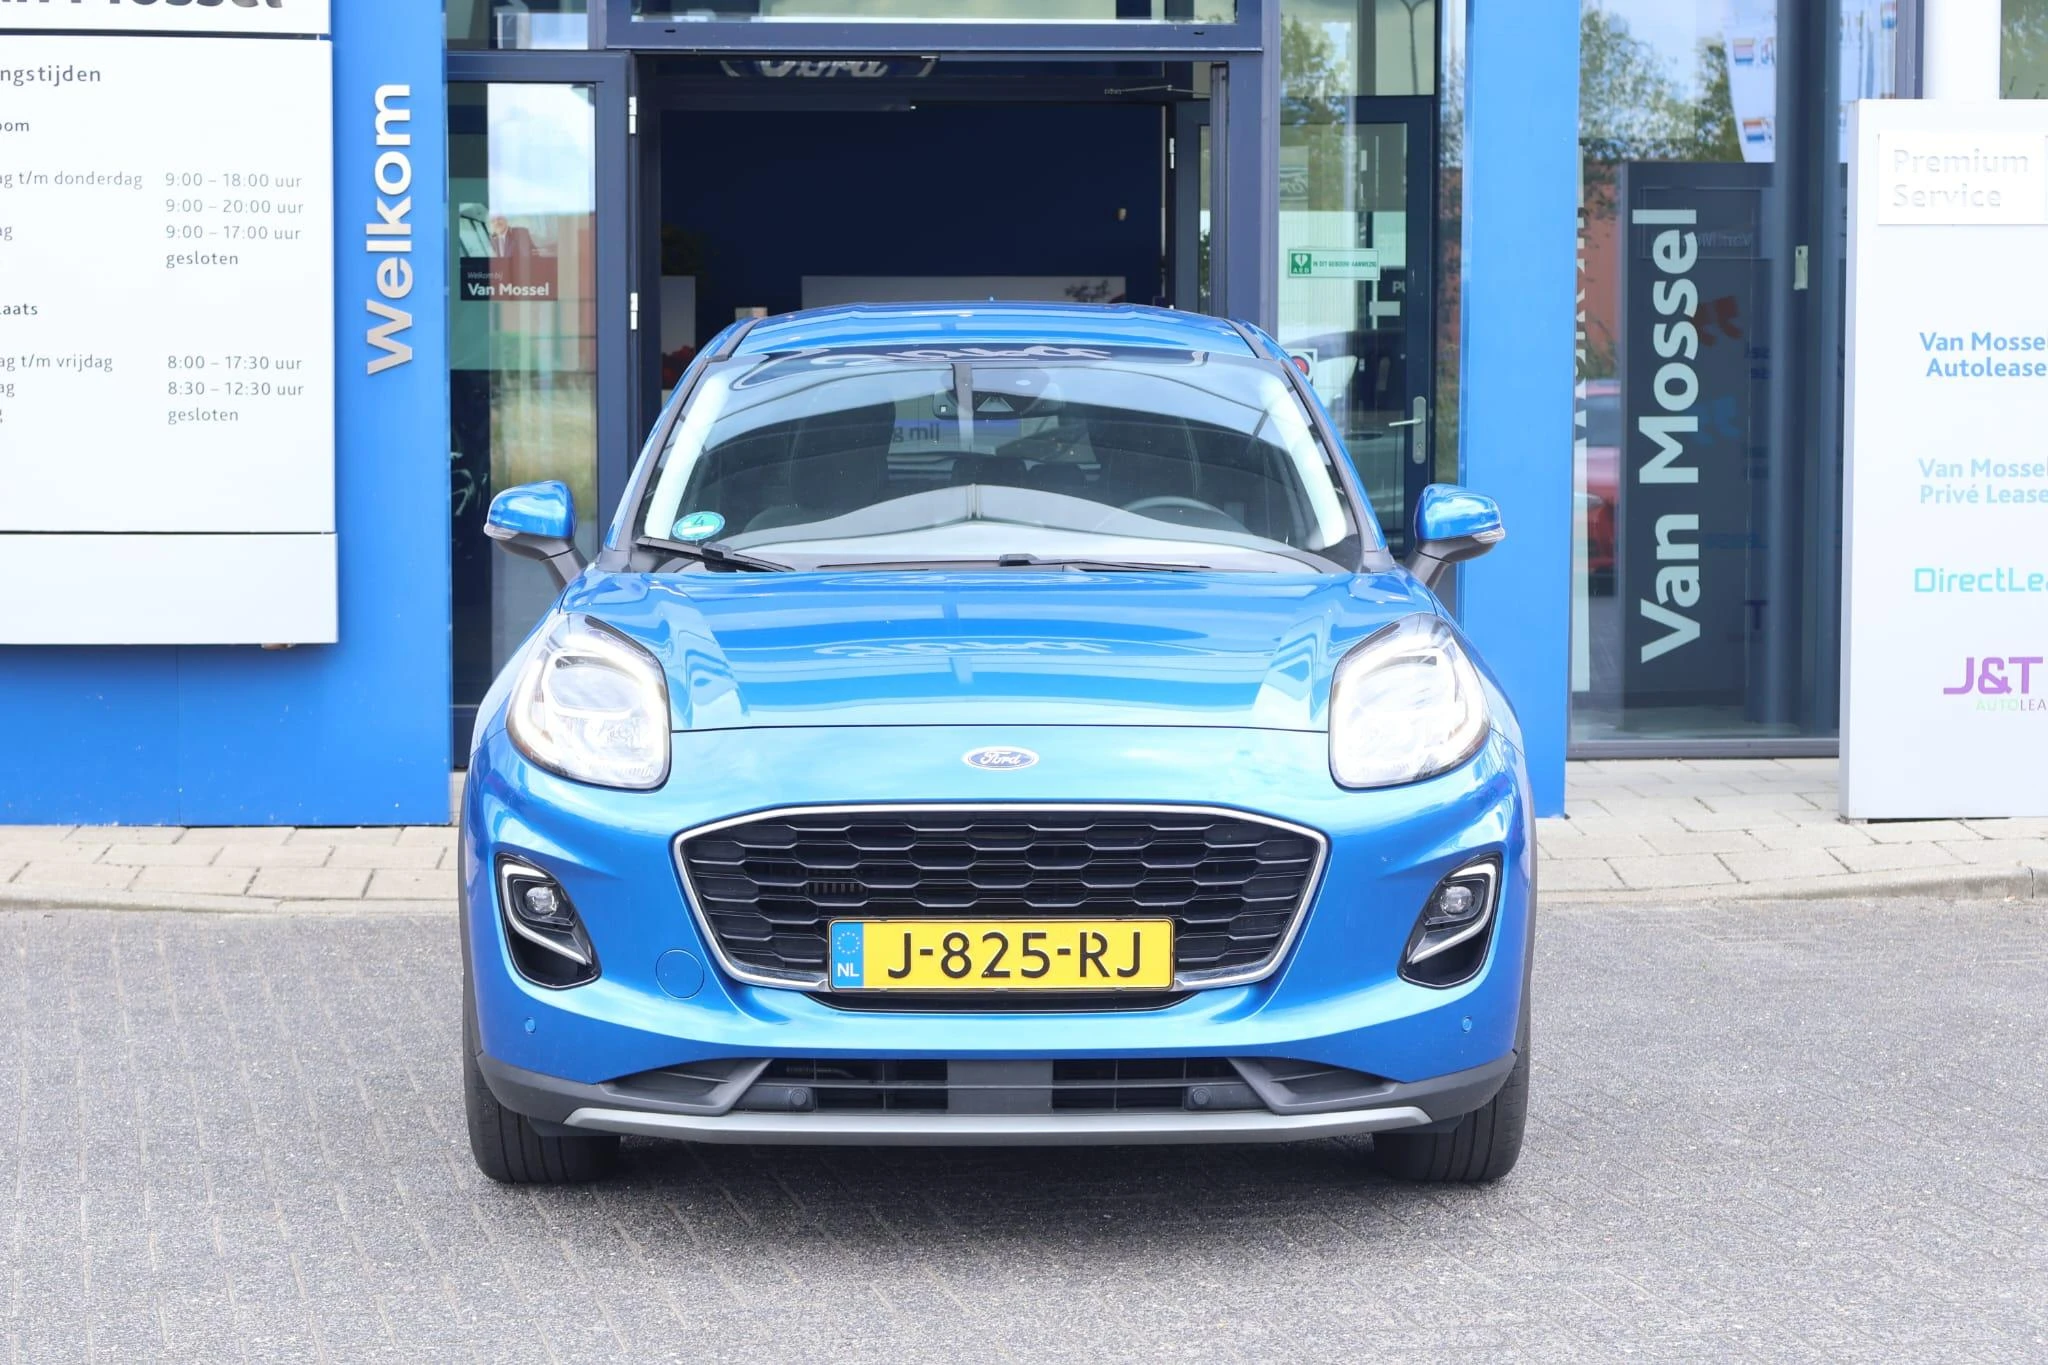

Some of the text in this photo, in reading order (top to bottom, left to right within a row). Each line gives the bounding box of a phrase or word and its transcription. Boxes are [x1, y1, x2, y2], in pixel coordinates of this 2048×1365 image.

[0, 121, 30, 132] om
[1893, 147, 2029, 173] Premium
[18, 170, 49, 185] t/m
[54, 170, 144, 190] donderdag
[165, 171, 203, 186] 9:00
[223, 172, 269, 188] 18:00
[275, 176, 303, 188] uur
[1893, 183, 2001, 207] Service
[165, 198, 203, 213] 9:00
[223, 199, 271, 214] 20:00
[276, 203, 304, 214] uur
[165, 225, 203, 239] 9:00
[223, 225, 268, 240] 17:00
[274, 228, 303, 240] uur
[365, 83, 414, 376] Welkom
[165, 250, 239, 269] gesloten
[467, 281, 549, 296] Van Mossel
[0, 303, 38, 315] aats
[1919, 332, 1964, 351] Van
[21, 353, 50, 368] t/m
[56, 354, 113, 372] vrijdag
[168, 355, 205, 369] 8:00
[225, 355, 269, 370] 17:30
[275, 359, 302, 370] uur
[1926, 357, 2047, 377] Autolease
[168, 382, 205, 396] 8:30
[225, 382, 271, 396] 12:30
[276, 385, 304, 396] uur
[168, 407, 239, 425] gesloten
[1632, 208, 1702, 664] Van Mossel
[1918, 458, 1963, 478] Van
[1920, 484, 2048, 504] Privé Lease
[1914, 567, 2048, 593] DirectLe
[1943, 656, 2043, 695] J&T
[1976, 698, 2047, 712] AUTOLEA
[980, 751, 1022, 765] Ford
[887, 931, 1141, 979] J-825-RJ
[837, 964, 860, 977] NL
